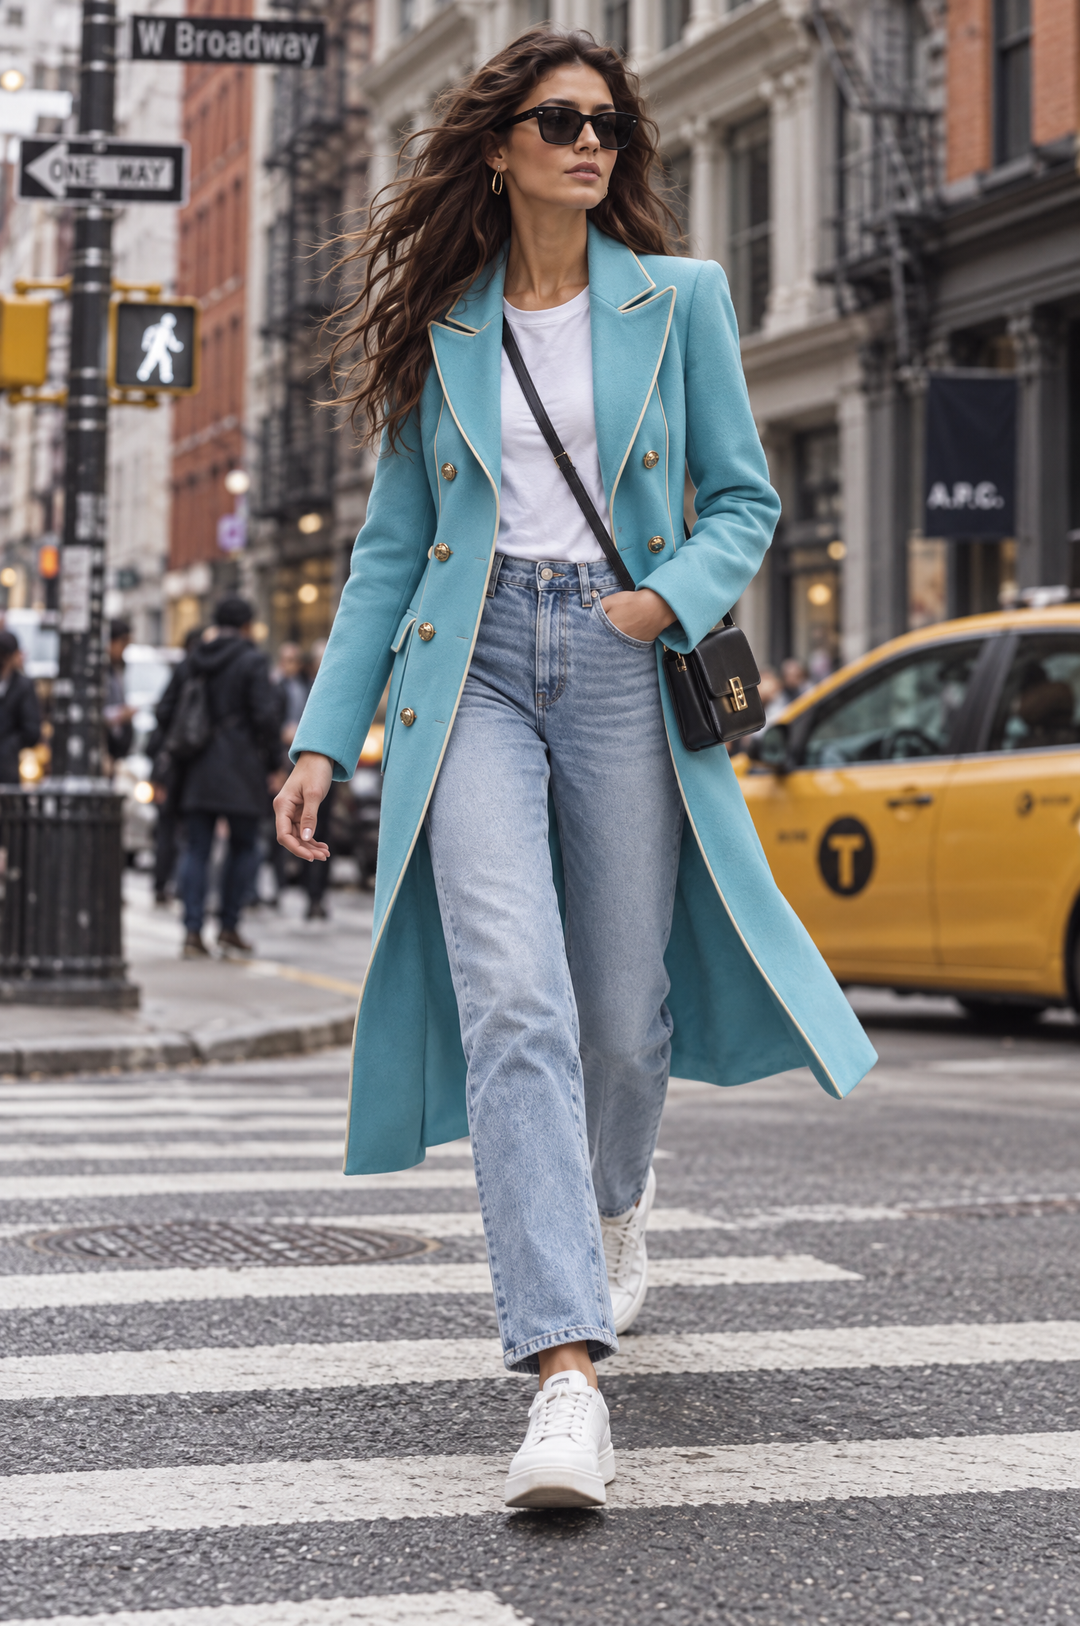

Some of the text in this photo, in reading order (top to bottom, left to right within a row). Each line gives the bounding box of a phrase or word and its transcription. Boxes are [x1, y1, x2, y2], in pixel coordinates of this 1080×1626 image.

[138, 20, 320, 69] W Broadway
[49, 158, 166, 186] ONE WAY
[828, 833, 865, 889] T
